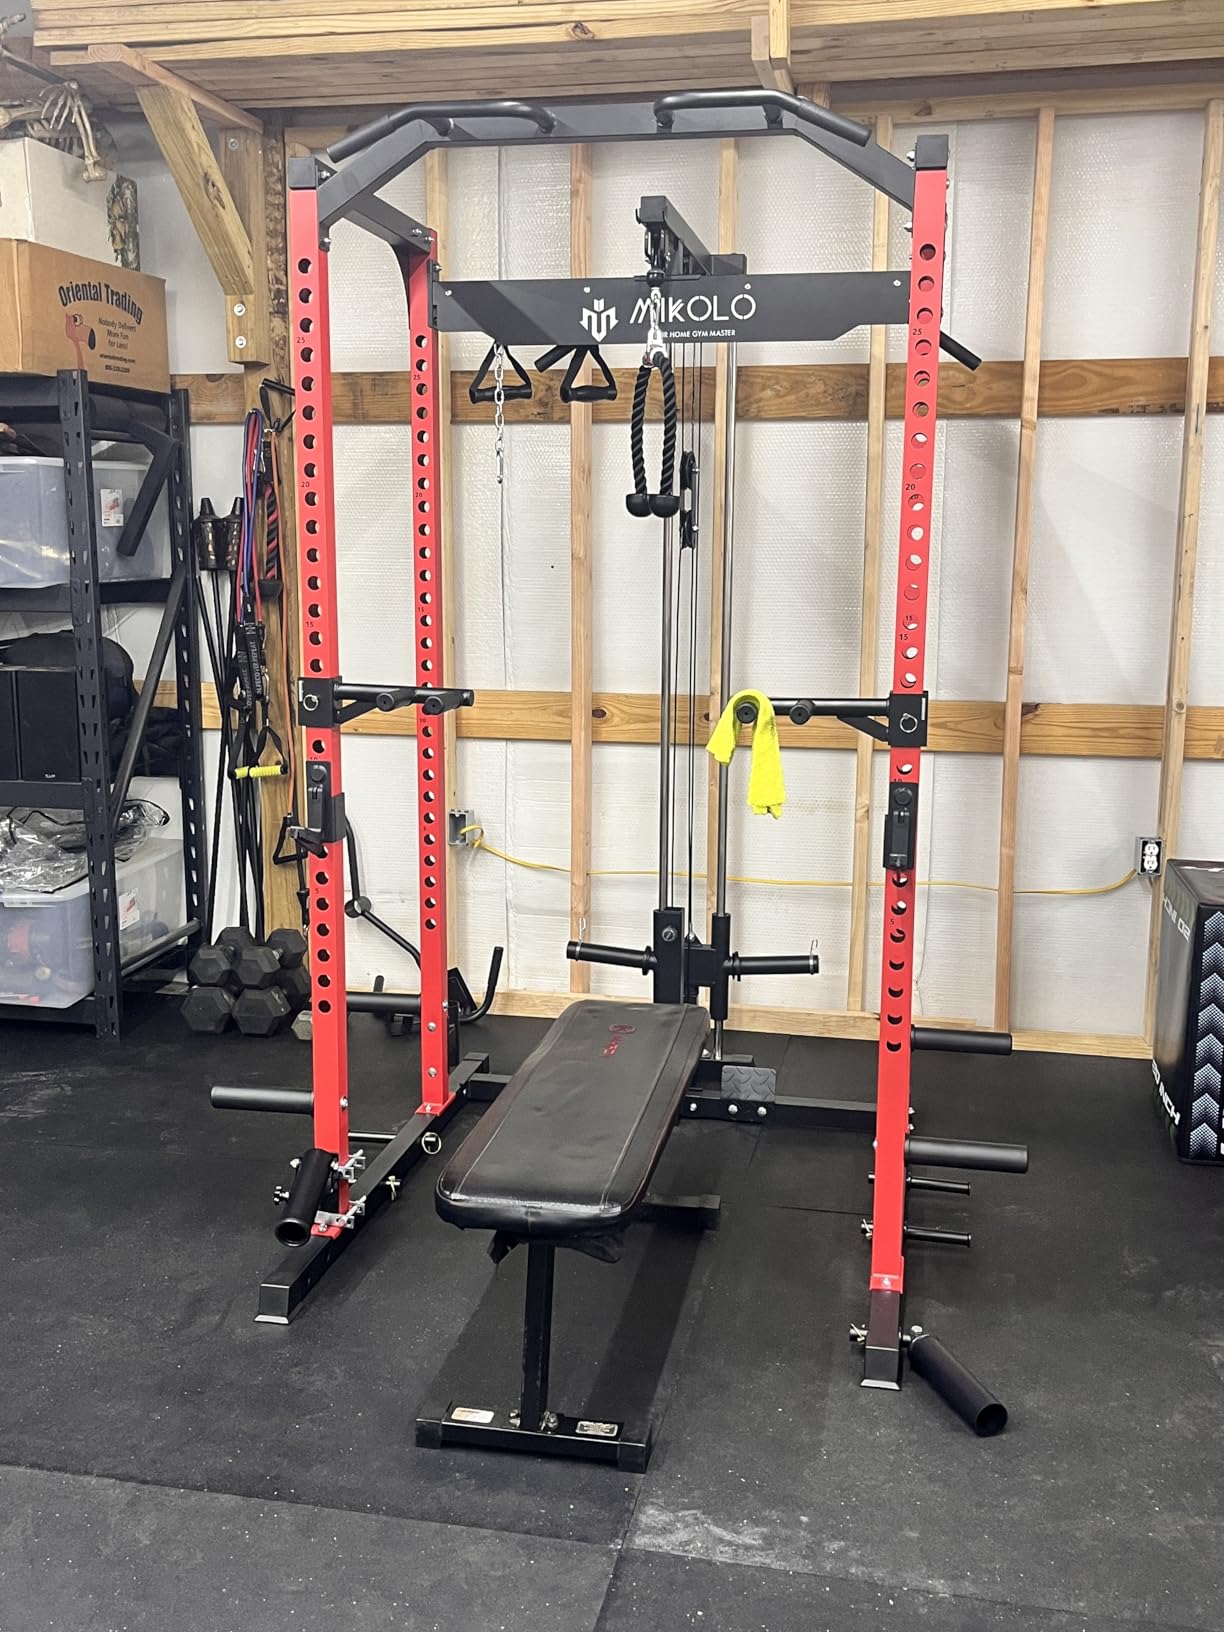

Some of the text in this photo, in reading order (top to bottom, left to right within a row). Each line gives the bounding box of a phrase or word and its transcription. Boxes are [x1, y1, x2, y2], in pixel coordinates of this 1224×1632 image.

[58, 281, 143, 325] Oriental Trading
[630, 294, 756, 324] MIKOLO
[296, 336, 306, 344] 25
[692, 330, 708, 338] GYM
[709, 329, 736, 337] MASTER
